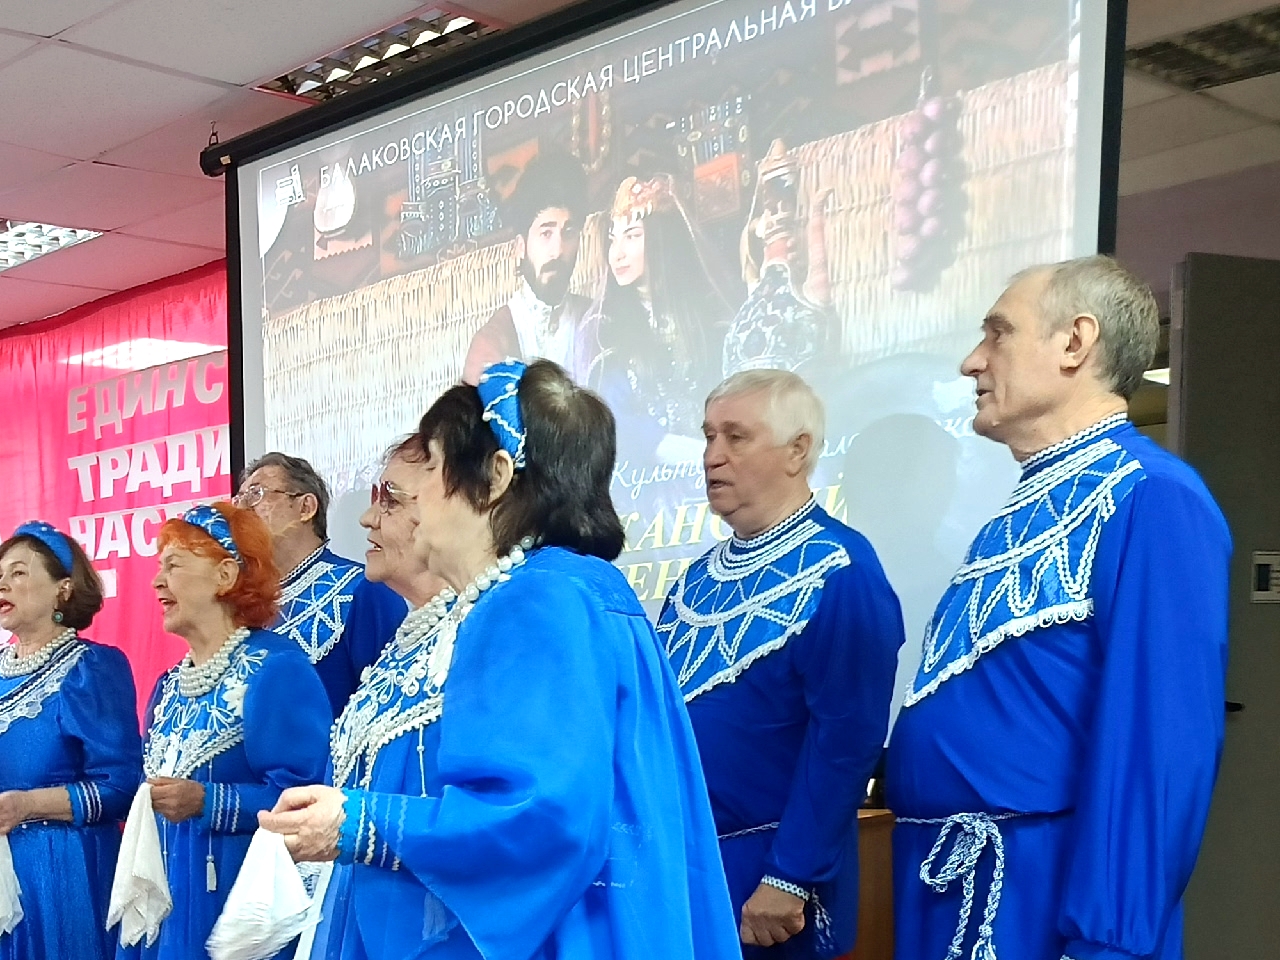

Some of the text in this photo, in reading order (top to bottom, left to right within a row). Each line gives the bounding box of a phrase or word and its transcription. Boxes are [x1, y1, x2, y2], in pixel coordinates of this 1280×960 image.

[319, 0, 818, 189] БАЛАКОВСКАЯ ГОРОДСКАЯ ЦЕНТРАЛЬНАЯ
[68, 500, 195, 563] НАС
